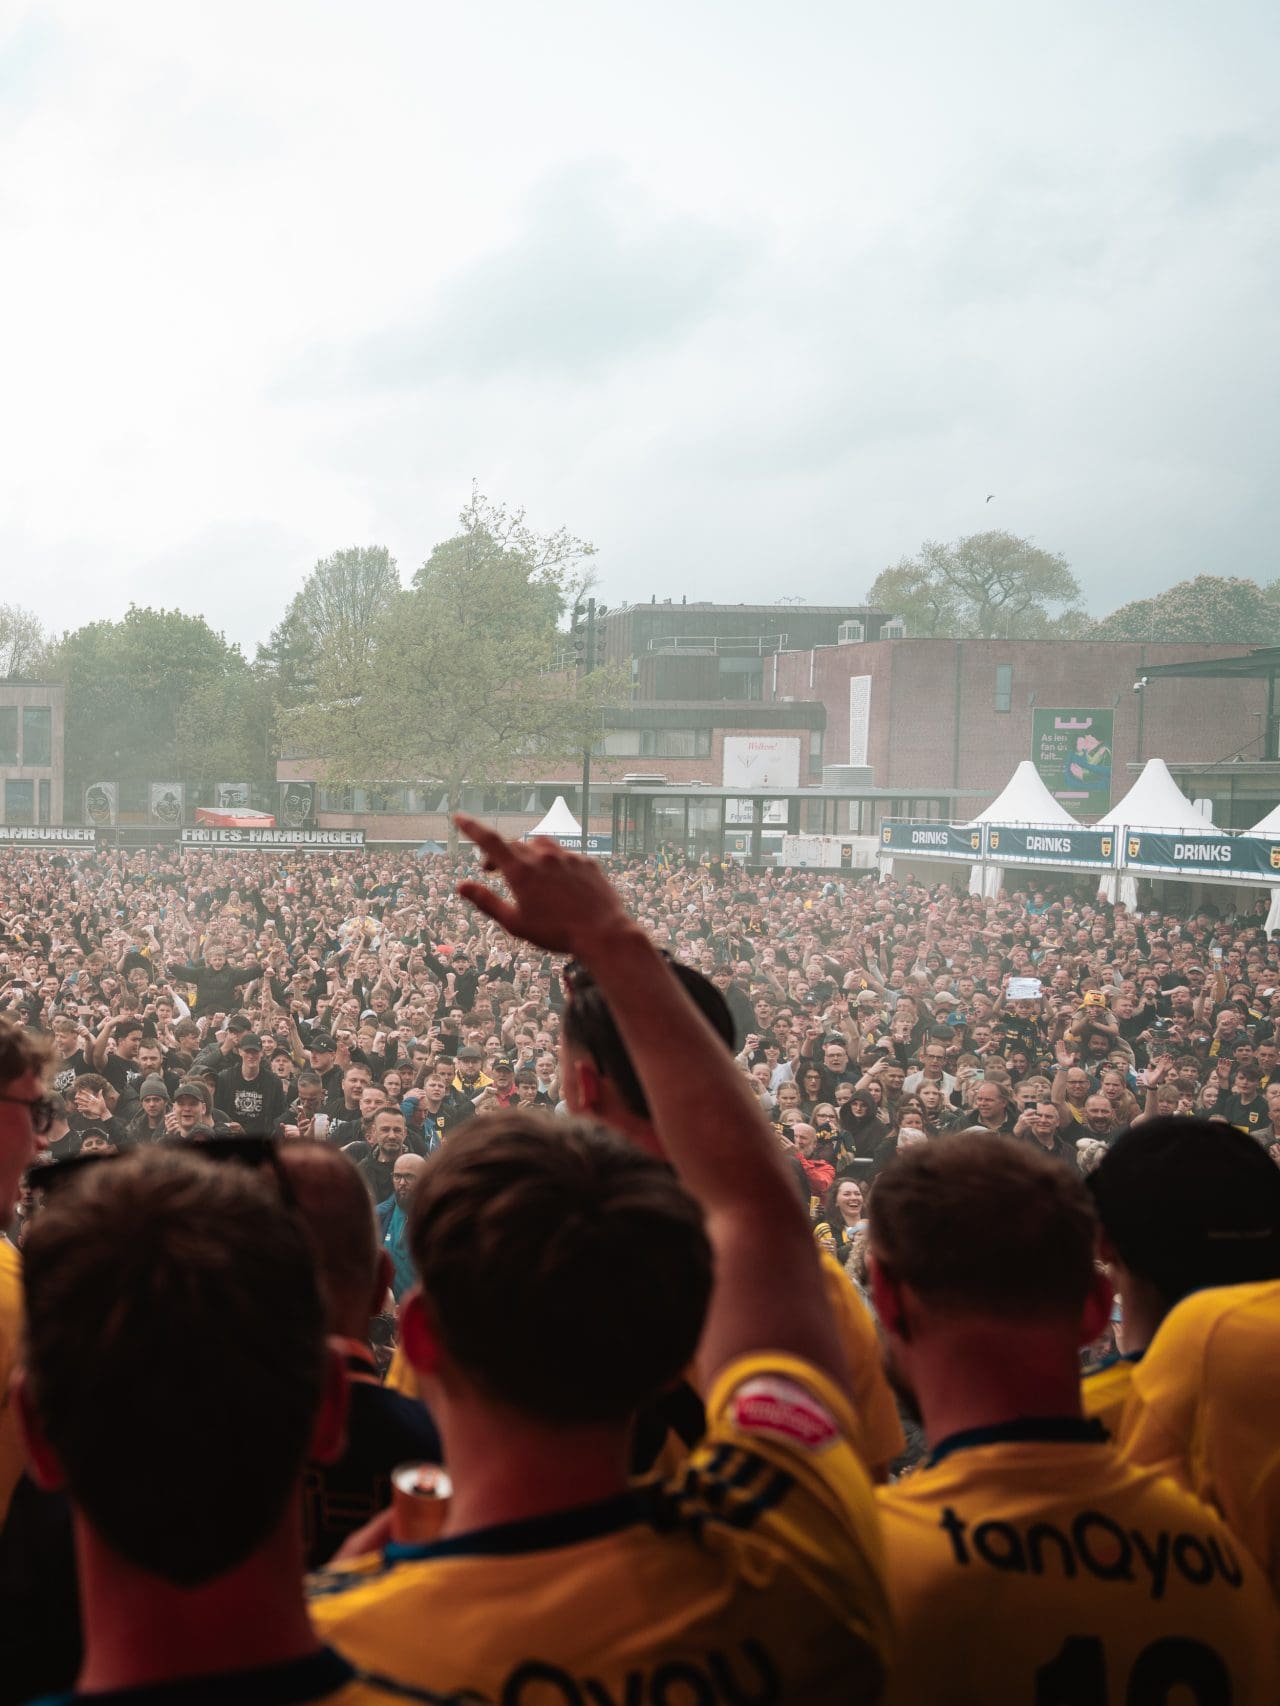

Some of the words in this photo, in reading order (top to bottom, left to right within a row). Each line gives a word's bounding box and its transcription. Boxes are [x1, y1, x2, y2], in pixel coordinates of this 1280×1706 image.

[912, 830, 948, 846] DRINKS
[1026, 835, 1071, 853] DRINKS
[1173, 843, 1231, 862] DRINKS
[939, 1506, 1244, 1602] tanQyou
